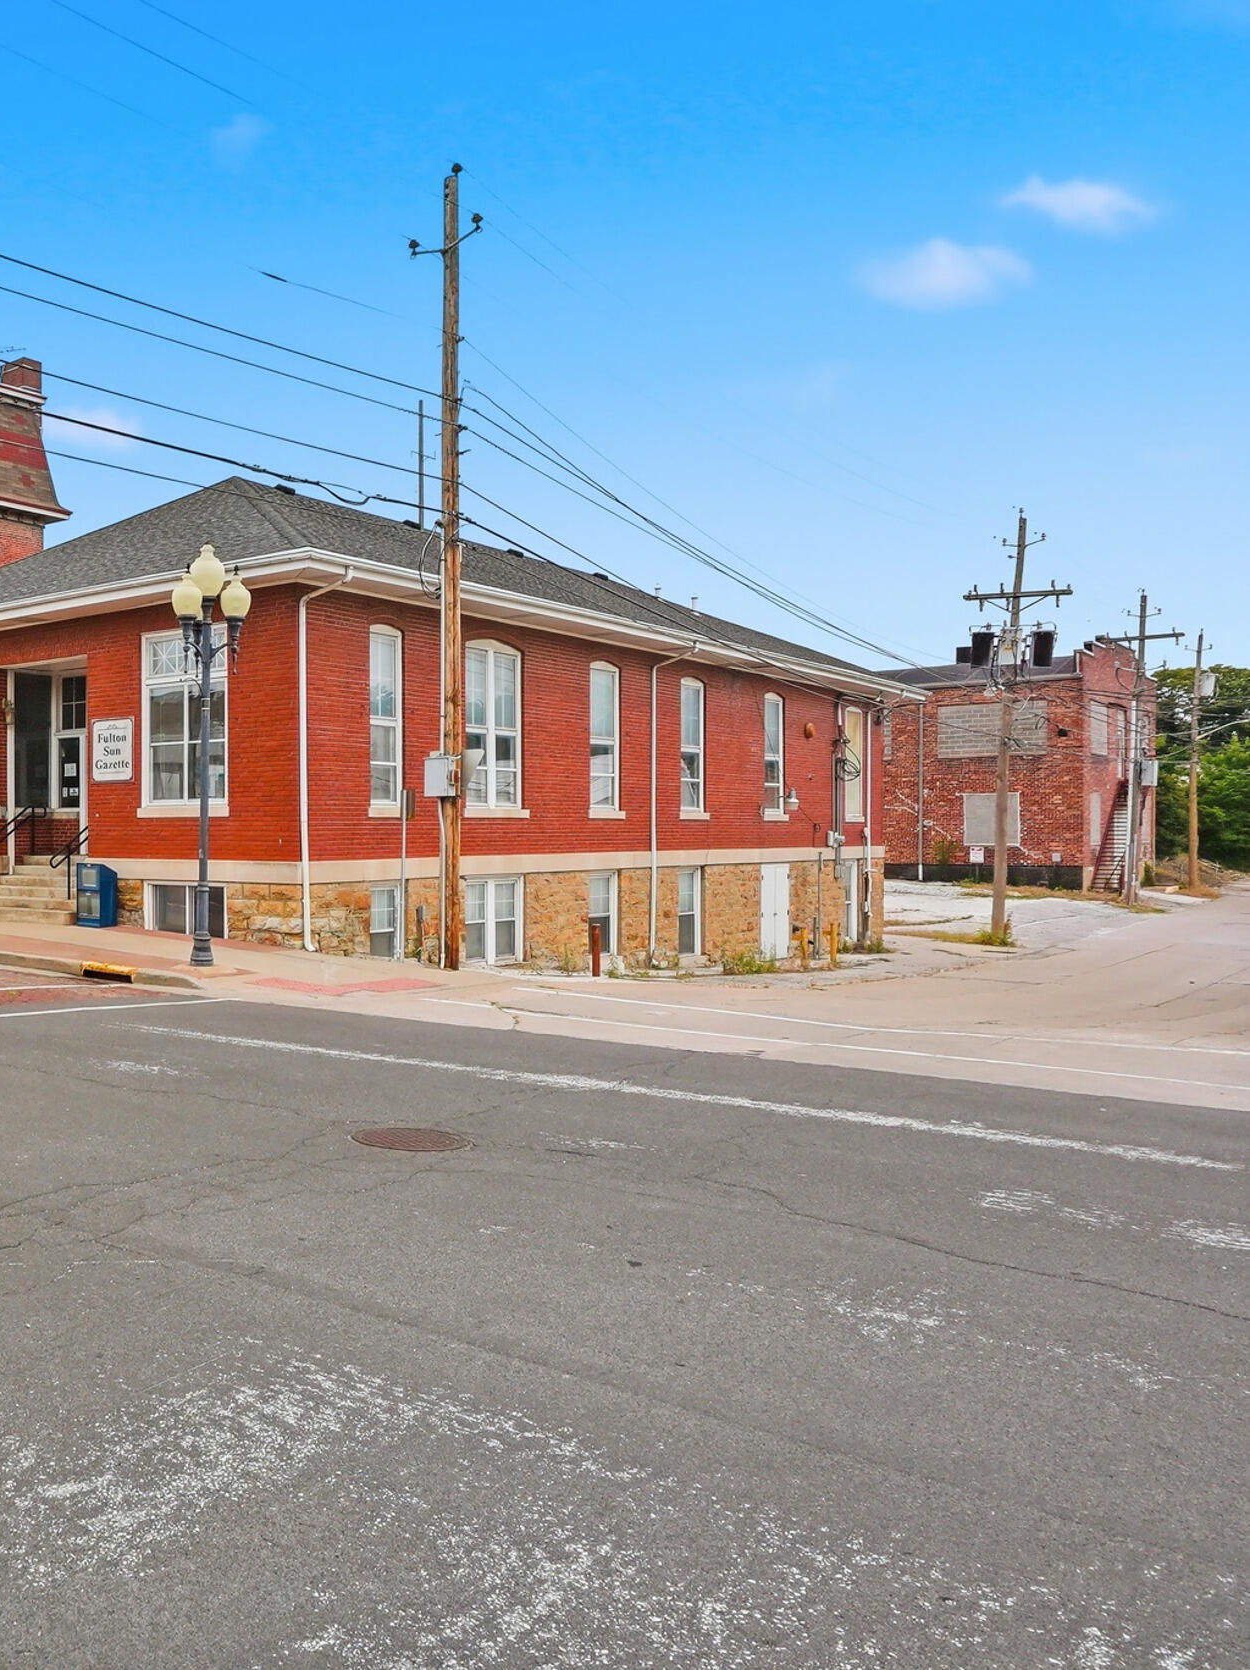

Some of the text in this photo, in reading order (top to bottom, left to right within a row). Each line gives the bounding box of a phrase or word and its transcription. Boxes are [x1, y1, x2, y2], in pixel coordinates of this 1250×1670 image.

[97, 732, 127, 743] Fulton
[103, 745, 121, 757] Sun
[94, 758, 130, 770] Gazette
